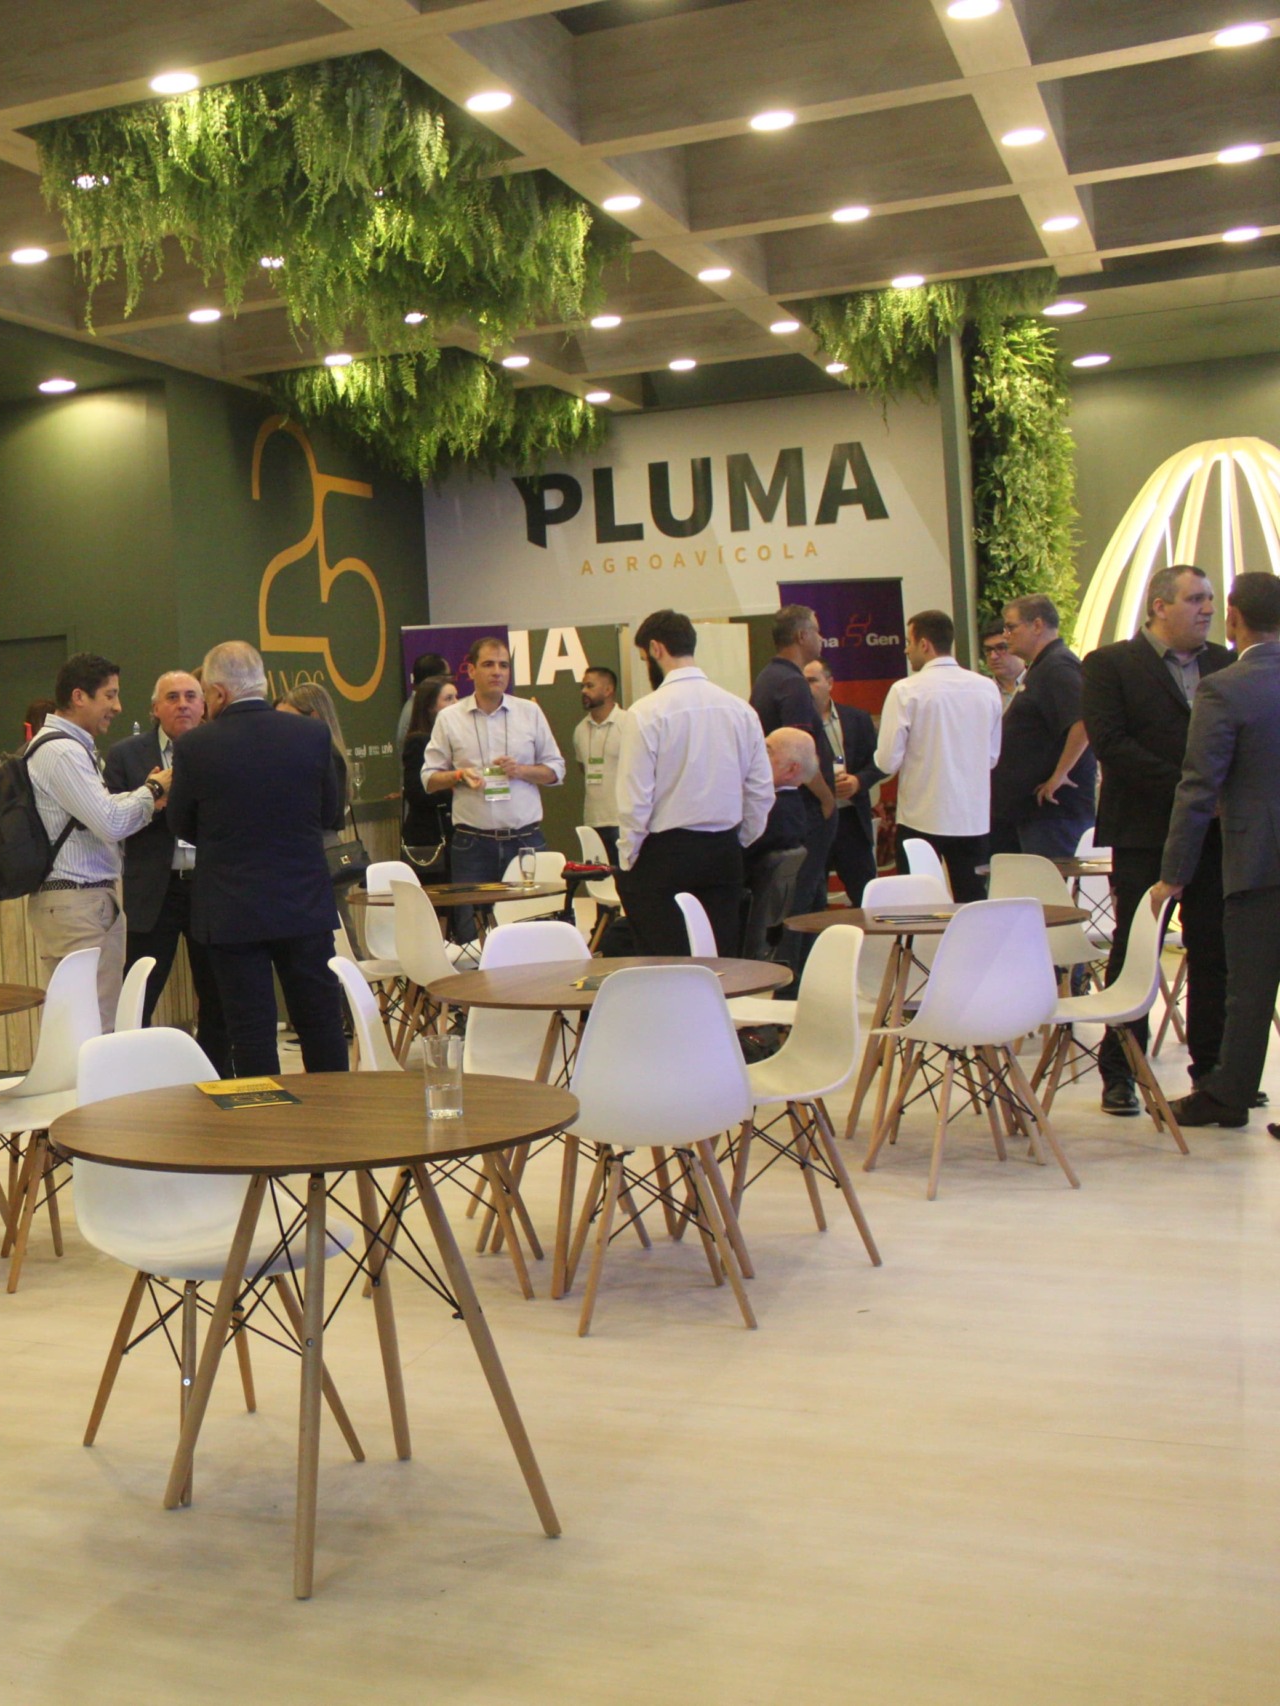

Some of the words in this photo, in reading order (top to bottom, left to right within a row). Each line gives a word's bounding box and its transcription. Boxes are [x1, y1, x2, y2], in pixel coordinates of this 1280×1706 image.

[511, 441, 890, 550] PLUMA
[580, 540, 819, 576] AGROAVÍCOLA
[865, 631, 901, 647] Gen
